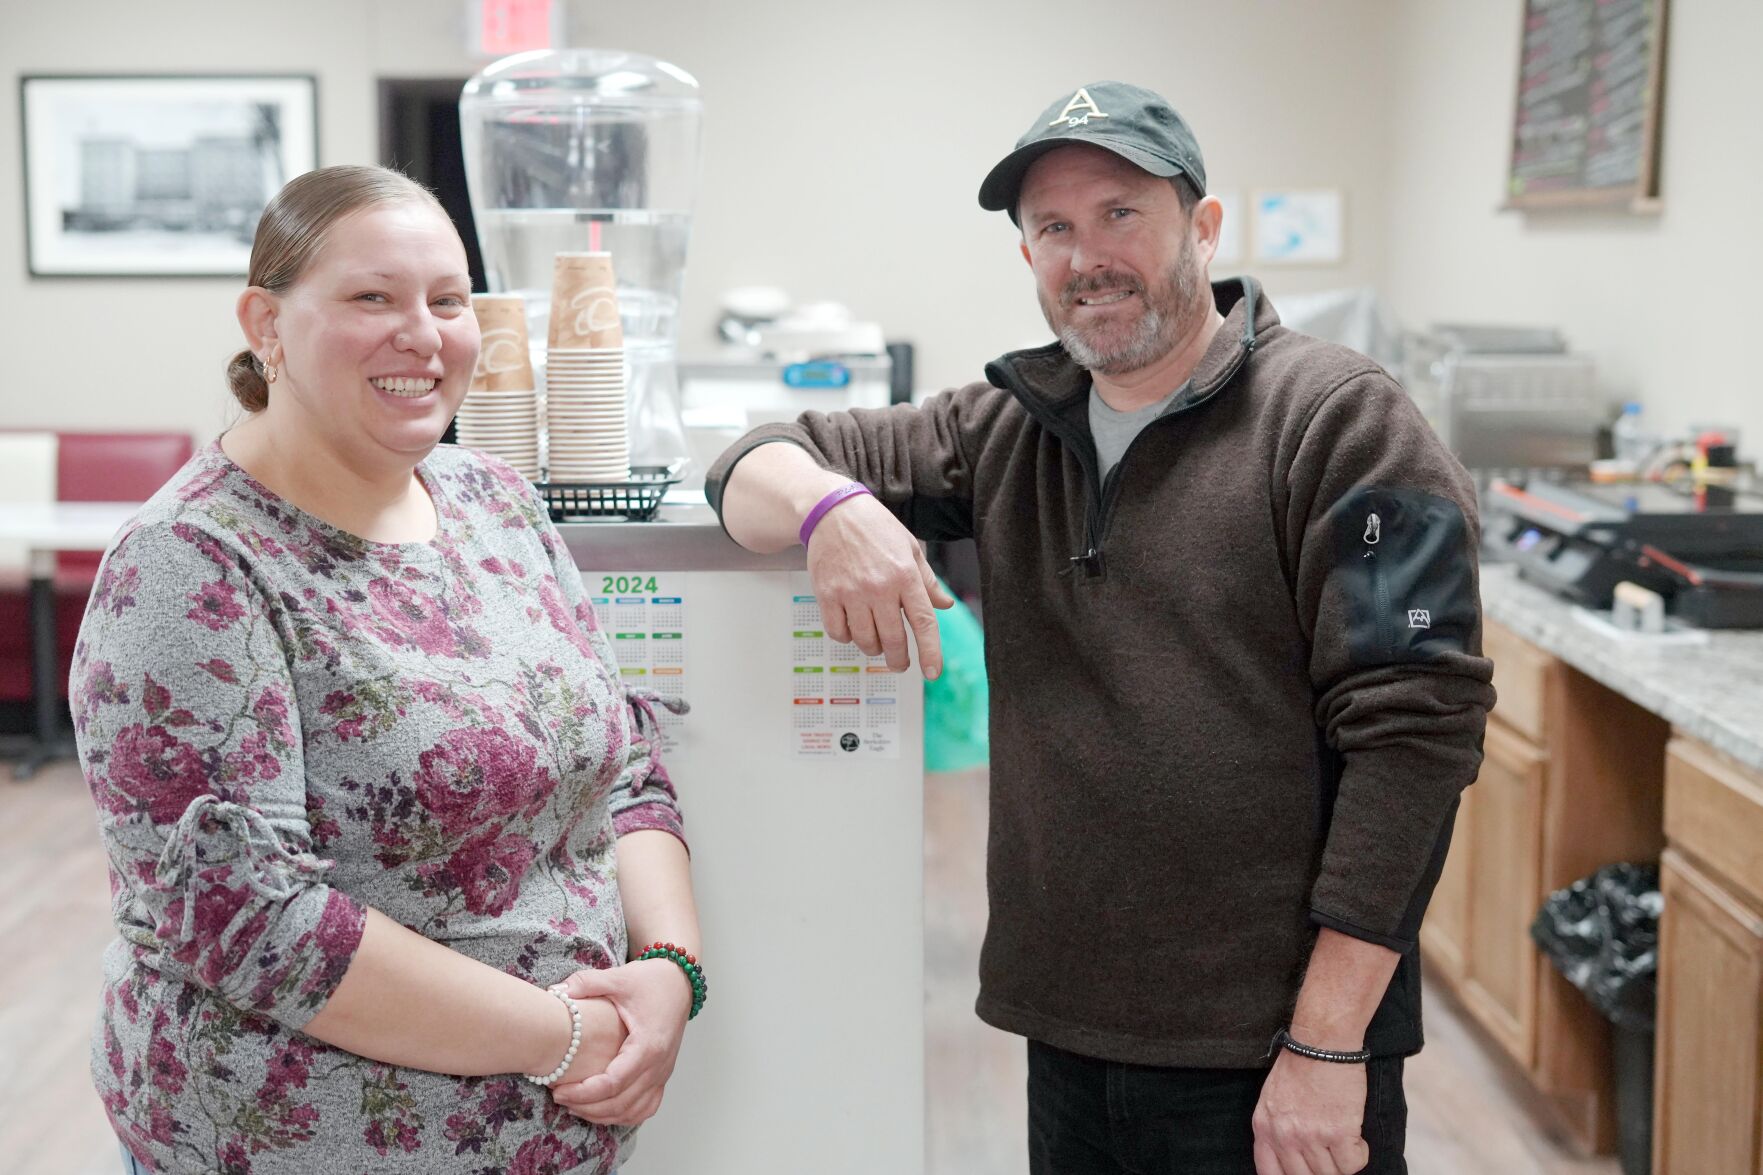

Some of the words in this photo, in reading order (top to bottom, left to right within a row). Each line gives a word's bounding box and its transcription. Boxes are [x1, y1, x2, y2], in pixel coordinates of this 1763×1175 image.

[1049, 88, 1109, 126] A
[1068, 115, 1089, 128] 94
[602, 576, 658, 594] 2024
